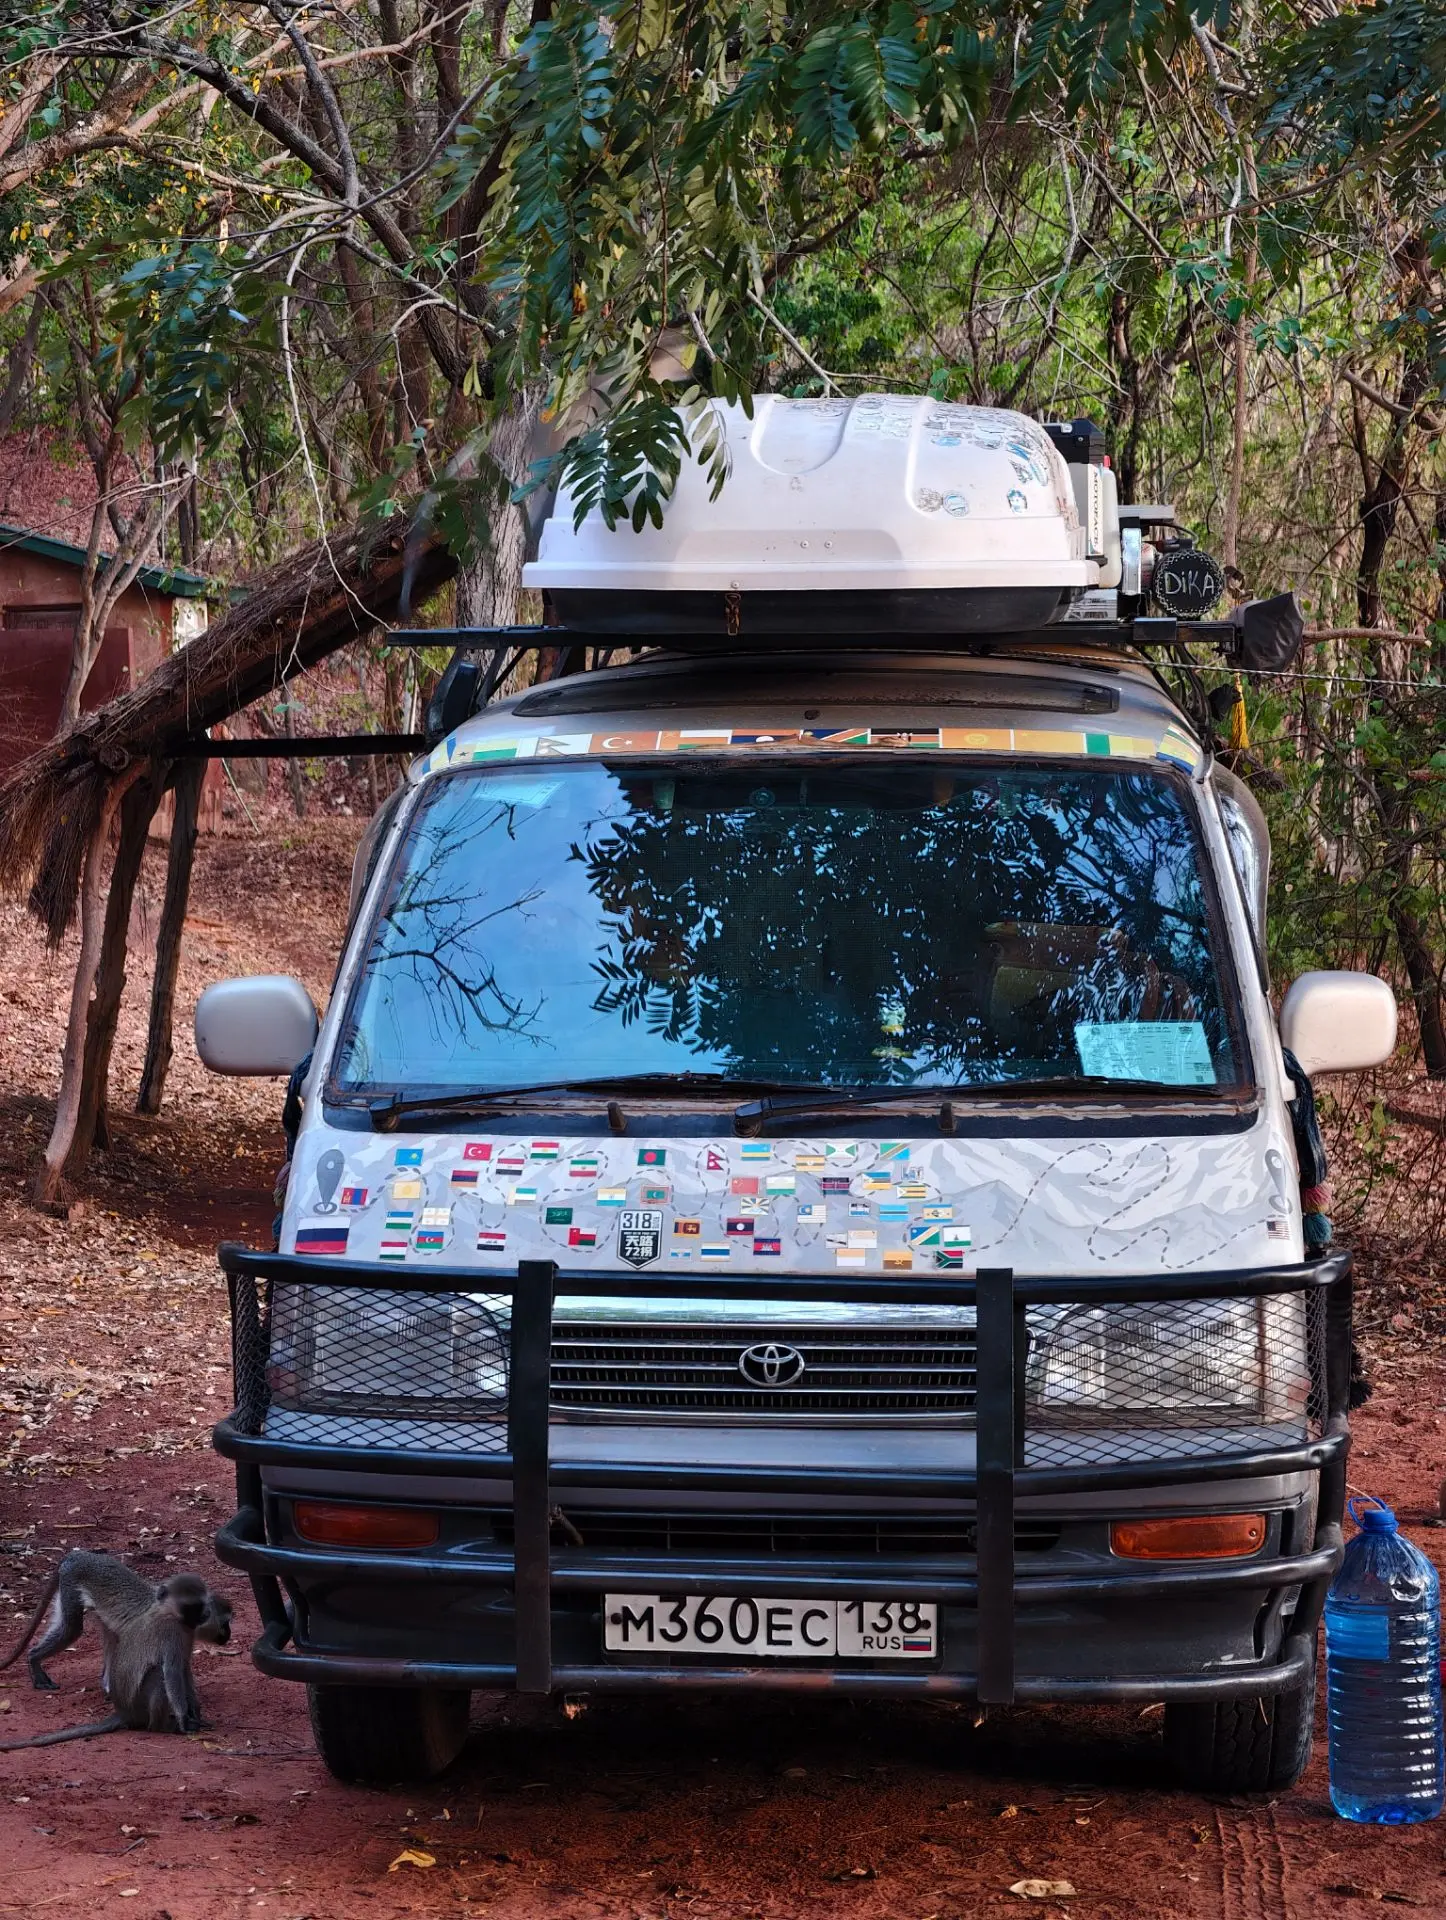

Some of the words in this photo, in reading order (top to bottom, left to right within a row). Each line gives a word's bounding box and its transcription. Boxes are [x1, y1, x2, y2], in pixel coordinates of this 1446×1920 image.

[622, 1213, 652, 1229] 318
[844, 1601, 923, 1633] 138
[863, 1636, 901, 1649] RUS
